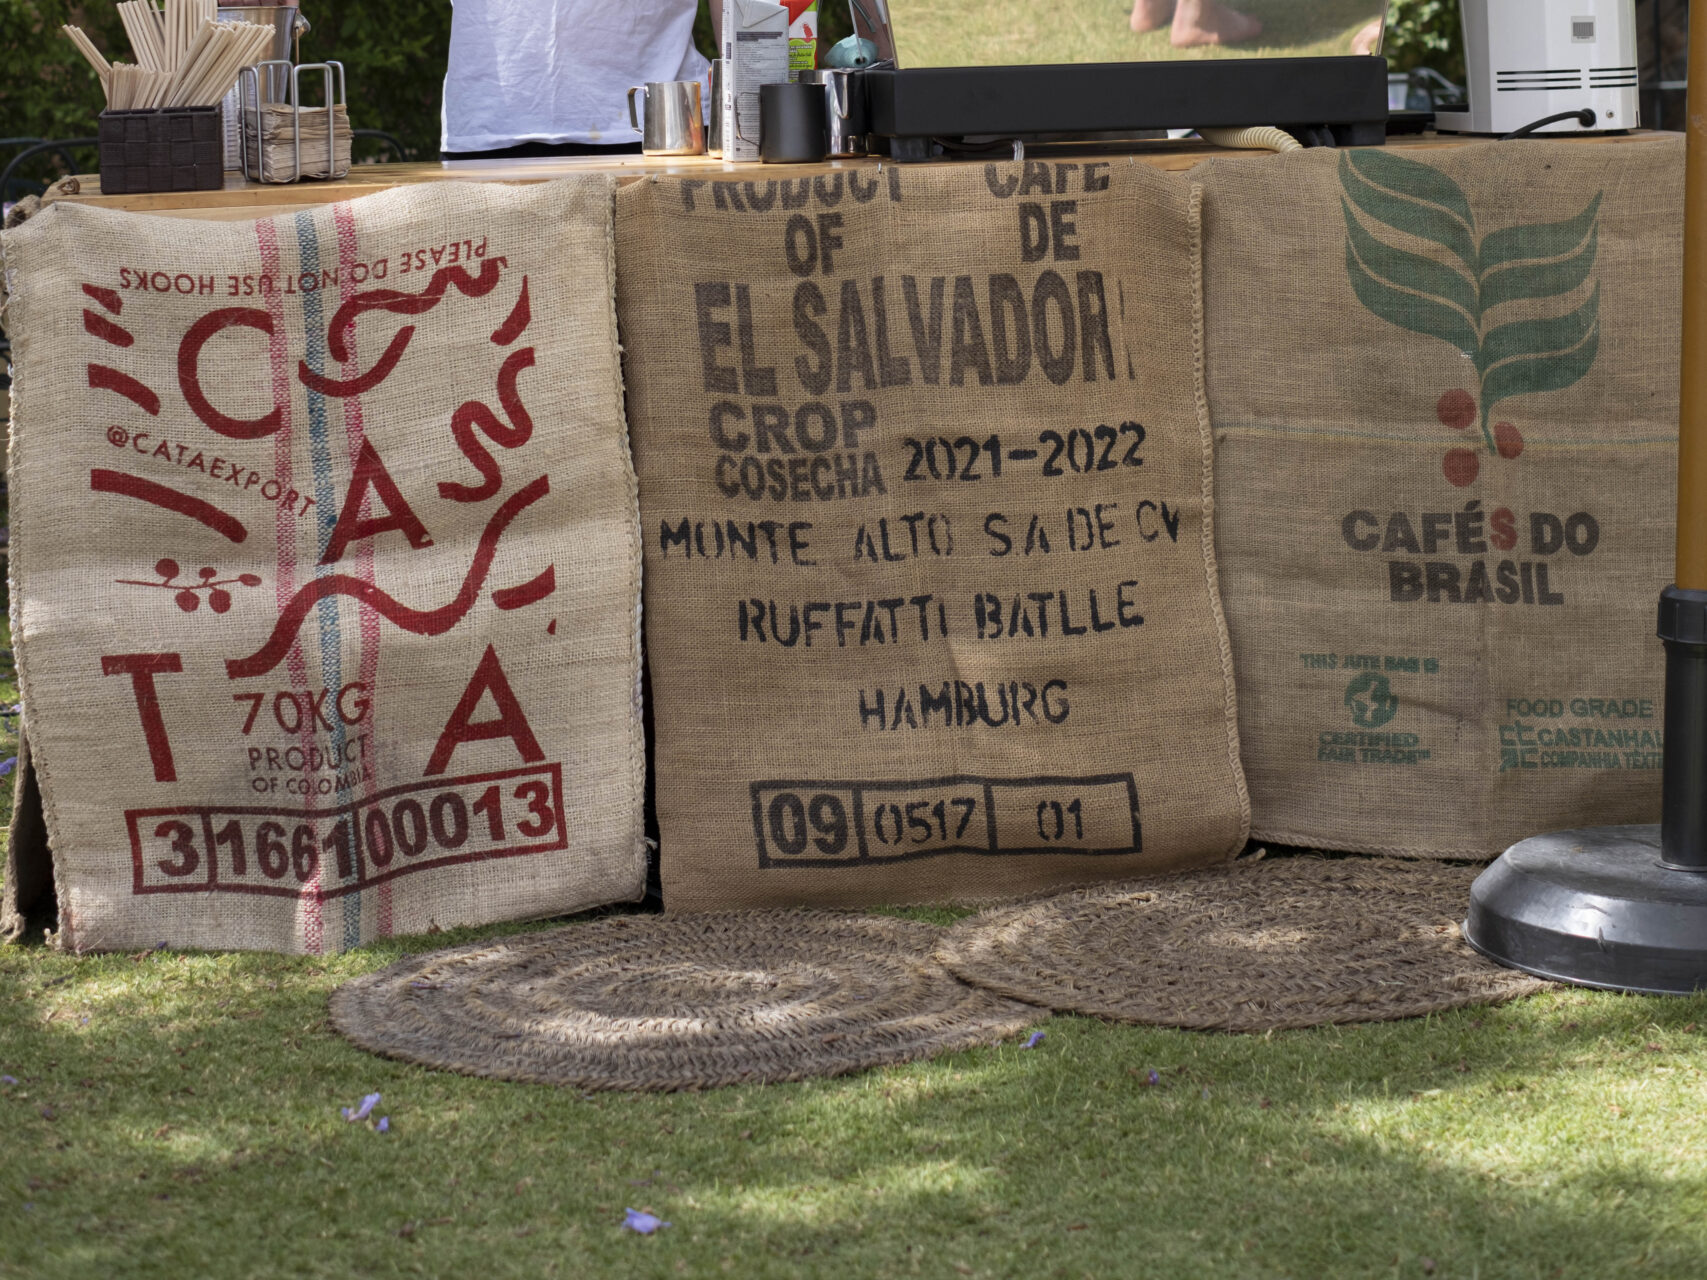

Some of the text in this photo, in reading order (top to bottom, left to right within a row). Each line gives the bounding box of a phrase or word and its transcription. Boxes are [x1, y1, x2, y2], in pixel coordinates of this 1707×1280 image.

[784, 212, 845, 277] OF
[1018, 200, 1080, 262] DE
[119, 236, 488, 296] PLEASE DO NOT USE HOOKS
[693, 269, 1136, 397] EL SALVADOR
[708, 399, 878, 455] CROP
[107, 425, 317, 517] @CATAEXPORT
[714, 449, 888, 502] COSECHA
[659, 516, 817, 566] MONTE
[854, 510, 954, 563] ALTO
[1067, 502, 1121, 552] DE
[1136, 499, 1180, 543] CV
[1341, 499, 1601, 556] CAFÉS DO
[1388, 559, 1565, 606] BRASIL
[738, 580, 1144, 647] RUFFATTI BATLLE
[232, 681, 371, 736] 70KG
[858, 678, 1071, 731] HAMBURG
[1506, 697, 1654, 718] FOOD GRADE
[248, 733, 368, 771] PRODUCT
[252, 777, 278, 793] OF
[768, 792, 1083, 855] 09 0517 01
